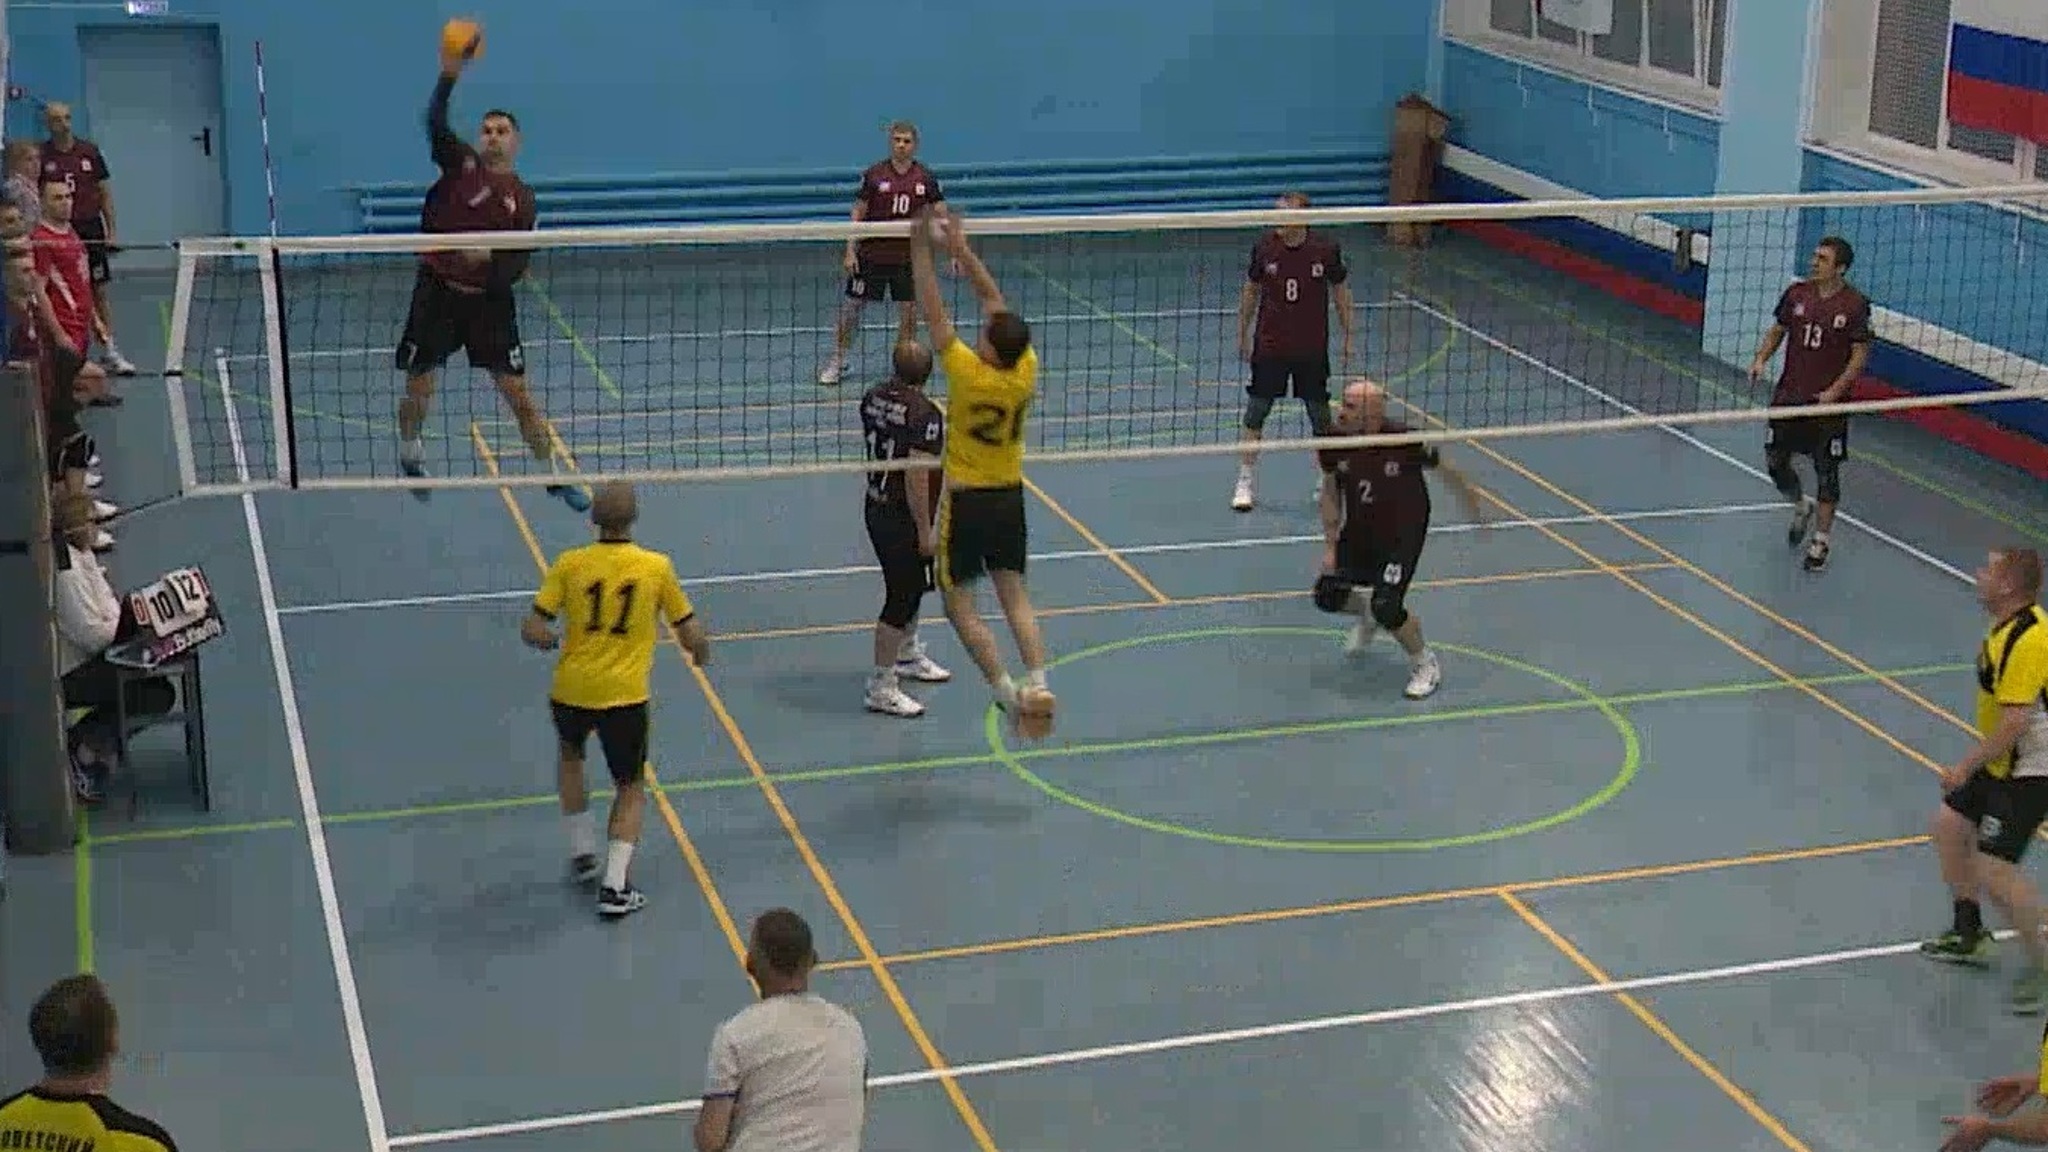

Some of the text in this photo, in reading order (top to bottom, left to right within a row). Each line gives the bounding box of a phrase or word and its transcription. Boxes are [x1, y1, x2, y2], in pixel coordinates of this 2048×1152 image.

[65, 173, 76, 193] 5
[892, 193, 910, 215] 10
[1286, 278, 1298, 302] 8
[1803, 324, 1822, 348] 13
[969, 402, 1023, 447] 21
[1358, 479, 1373, 504] 2
[149, 591, 175, 623] 10
[173, 574, 200, 601] 12
[585, 579, 637, 635] 11
